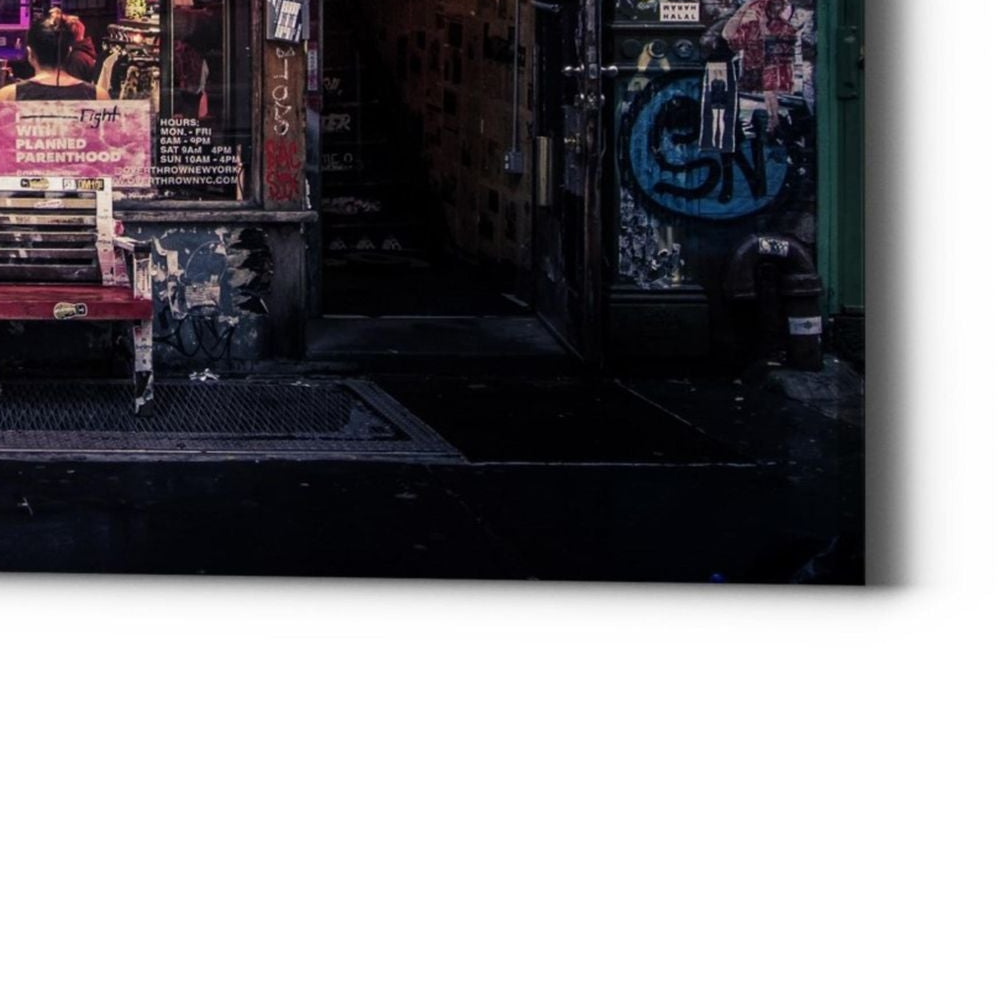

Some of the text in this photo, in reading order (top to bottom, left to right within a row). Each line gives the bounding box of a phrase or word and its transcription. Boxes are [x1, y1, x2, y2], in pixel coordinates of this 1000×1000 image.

[160, 118, 200, 127] HOURS:
[160, 127, 188, 137] MON.
[195, 127, 212, 136] FRI
[16, 138, 87, 151] PLANNED
[160, 136, 182, 145] 6AM
[160, 145, 179, 154] SAT
[211, 145, 232, 154] 4PM
[16, 151, 121, 164] PARENTHOOD
[160, 155, 182, 164] SUN
[185, 154, 211, 164] 10AM
